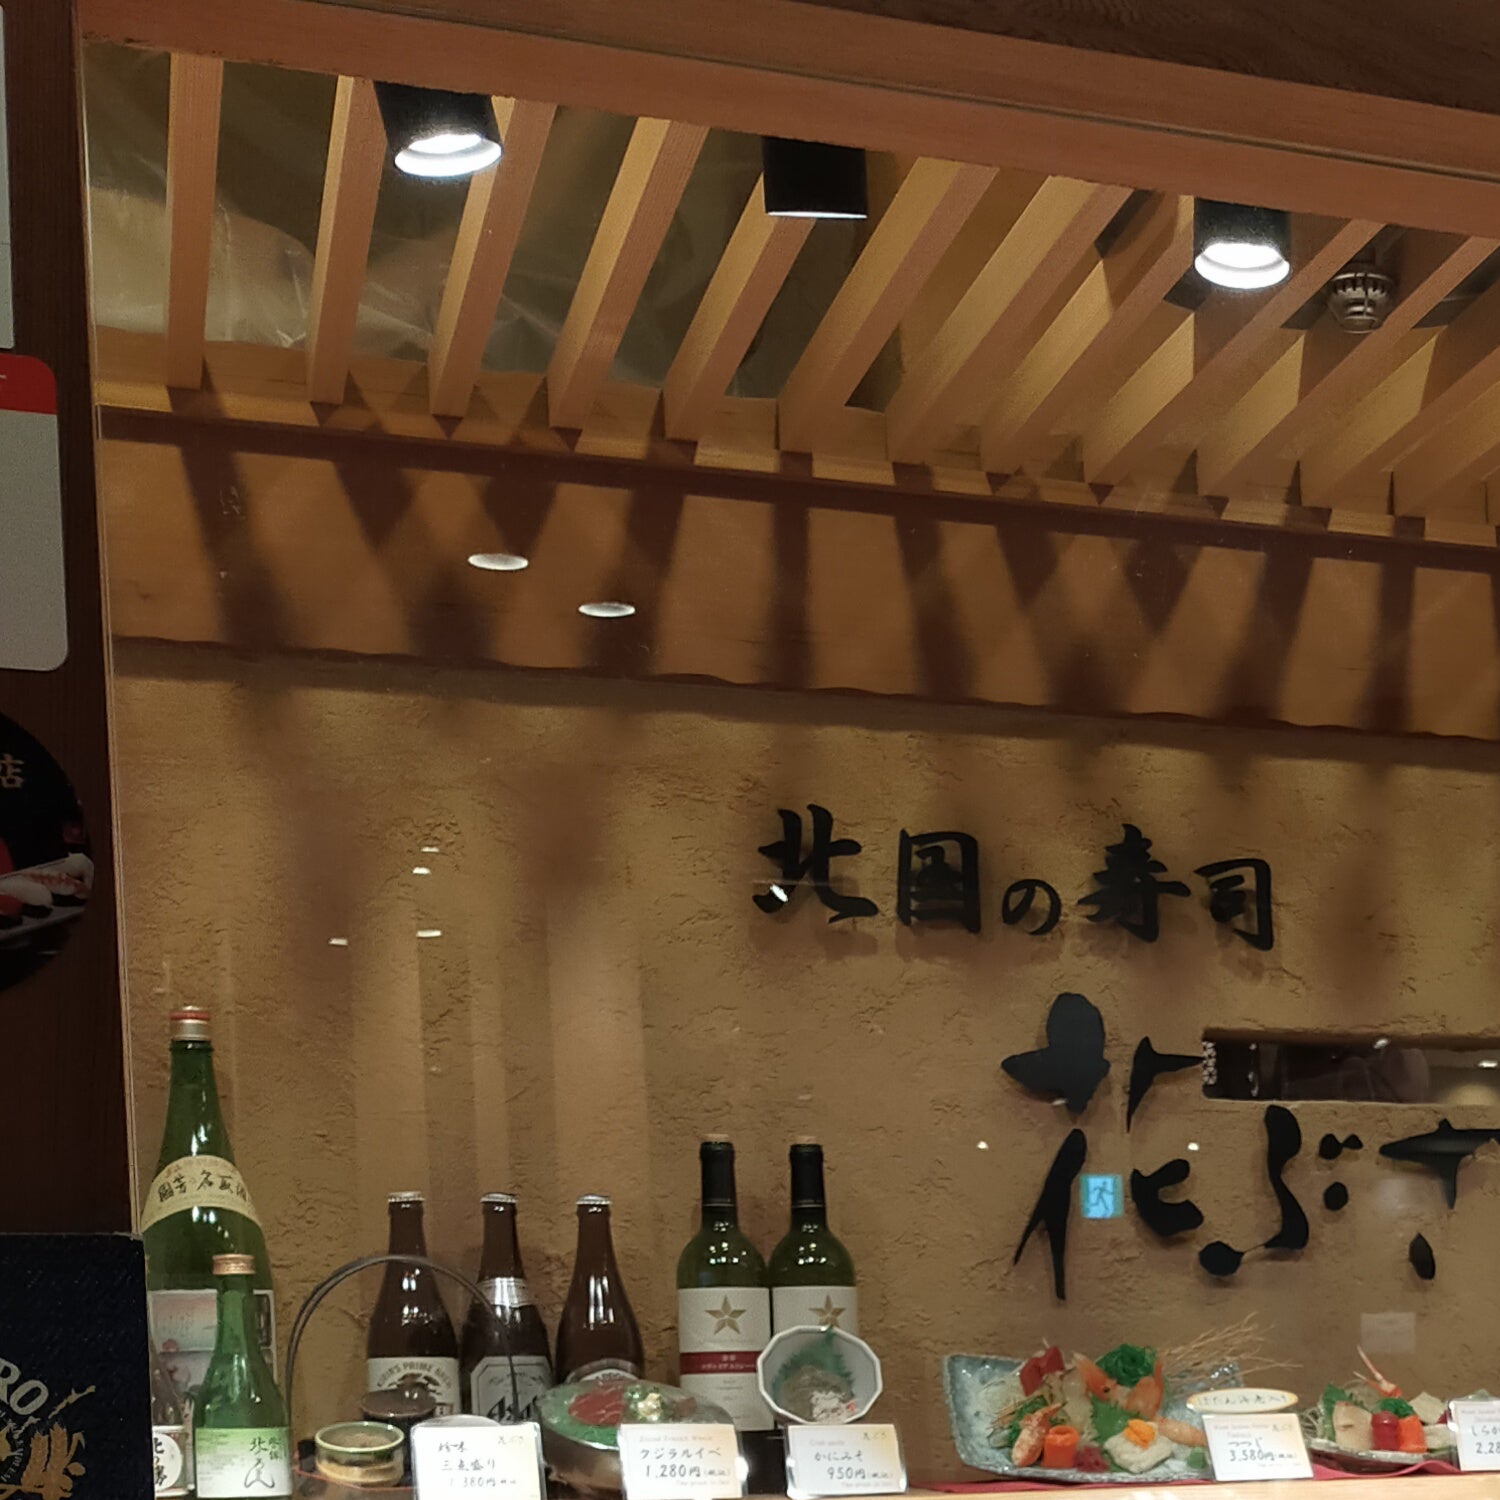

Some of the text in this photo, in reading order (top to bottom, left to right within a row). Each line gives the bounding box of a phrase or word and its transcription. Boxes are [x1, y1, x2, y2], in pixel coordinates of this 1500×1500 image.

[752, 803, 1275, 952] 北国の寿司
